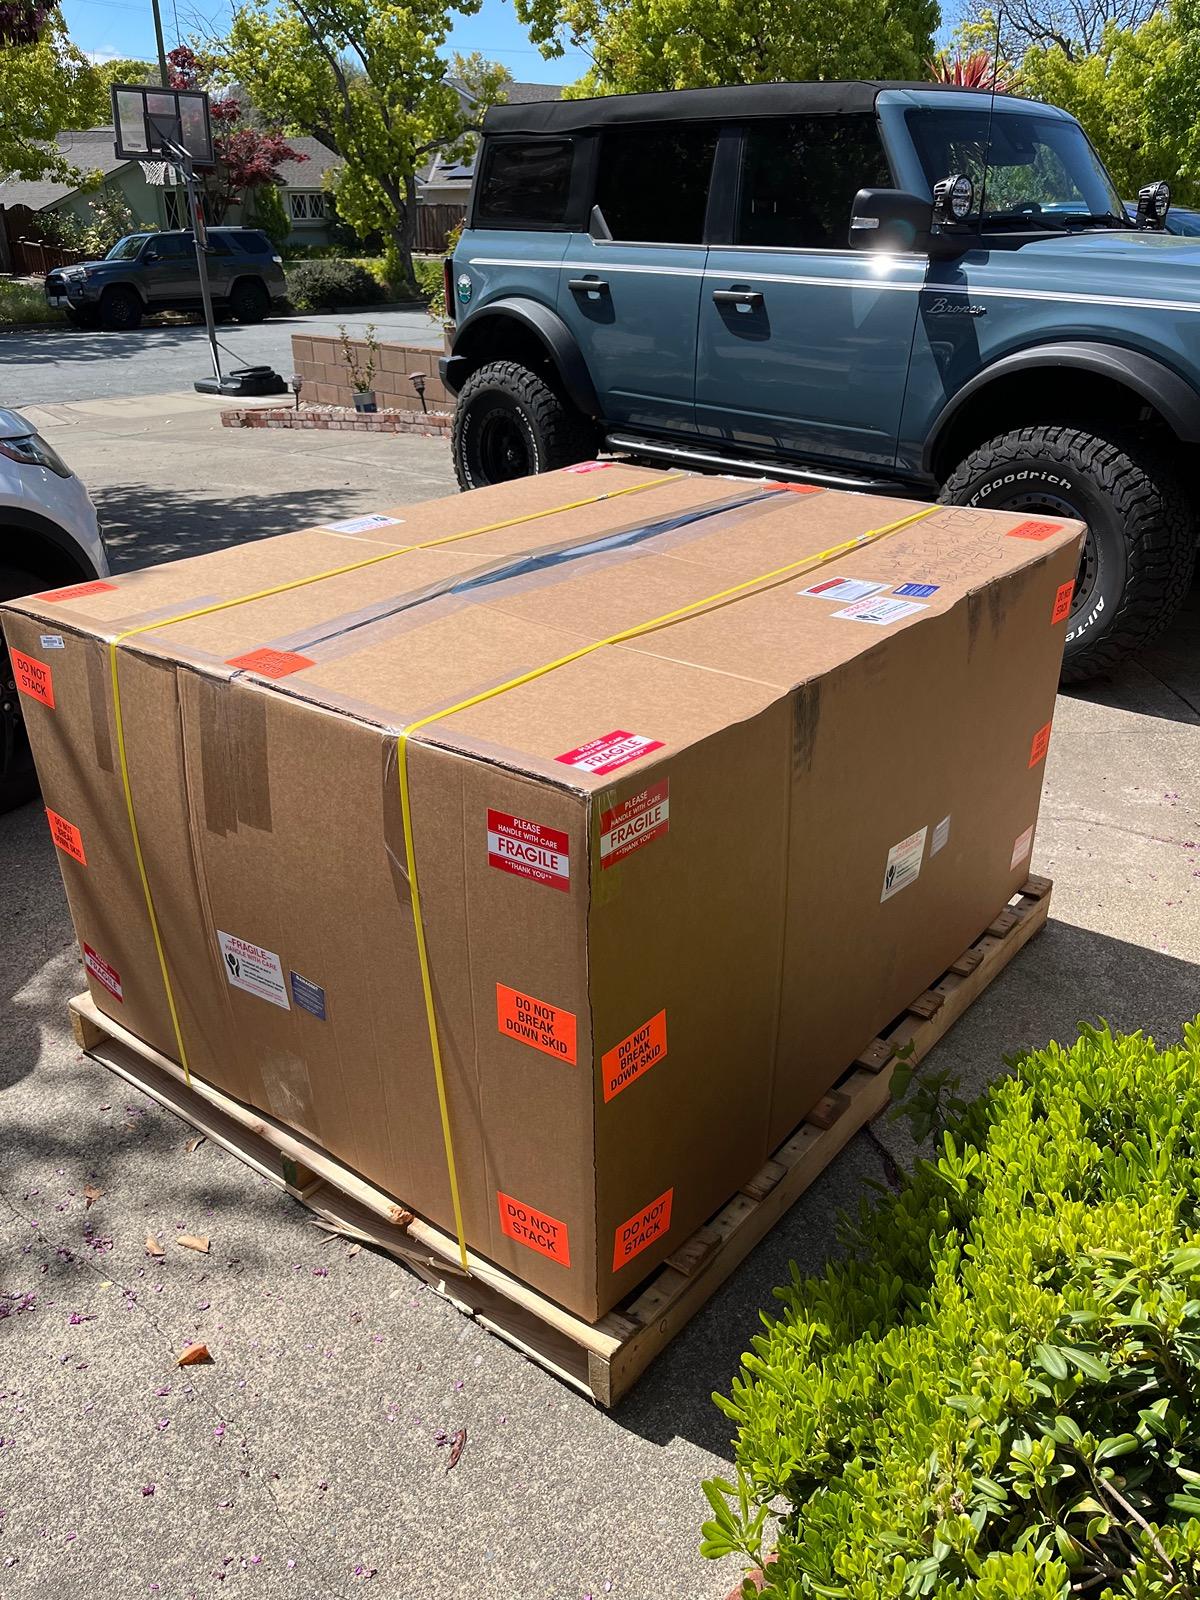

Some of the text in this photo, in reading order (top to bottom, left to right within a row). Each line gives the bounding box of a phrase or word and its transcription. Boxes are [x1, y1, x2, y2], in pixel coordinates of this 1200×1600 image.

[926, 298, 986, 314] Bronco
[965, 470, 1073, 507] FGoodrich
[1065, 595, 1105, 642] All-Te
[17, 658, 46, 682] DO NOT
[21, 674, 48, 698] STACK
[584, 740, 642, 766] FRAGILE
[610, 793, 662, 828] HANDLE WITH CARE
[625, 791, 648, 811] PLEASE
[498, 824, 558, 849] HANDLE WITH CARE
[513, 818, 541, 834] PLEASE
[610, 806, 662, 848] FRAGILE
[498, 837, 558, 870] FRAGILE
[225, 944, 278, 971] HANDLE WITH CARE
[90, 959, 118, 991] FRAGILE
[516, 996, 556, 1022] DO NOT
[518, 1011, 554, 1036] BREAK
[506, 1018, 567, 1054] DOWN SKID
[618, 1025, 651, 1059] DO NOT
[611, 1044, 660, 1091] DOWN SKID
[620, 1039, 650, 1069] BREAK
[508, 1204, 558, 1238] DO NOT
[512, 1221, 557, 1253] STACK
[623, 1200, 666, 1242] DO NOT
[624, 1218, 661, 1255] STACK
